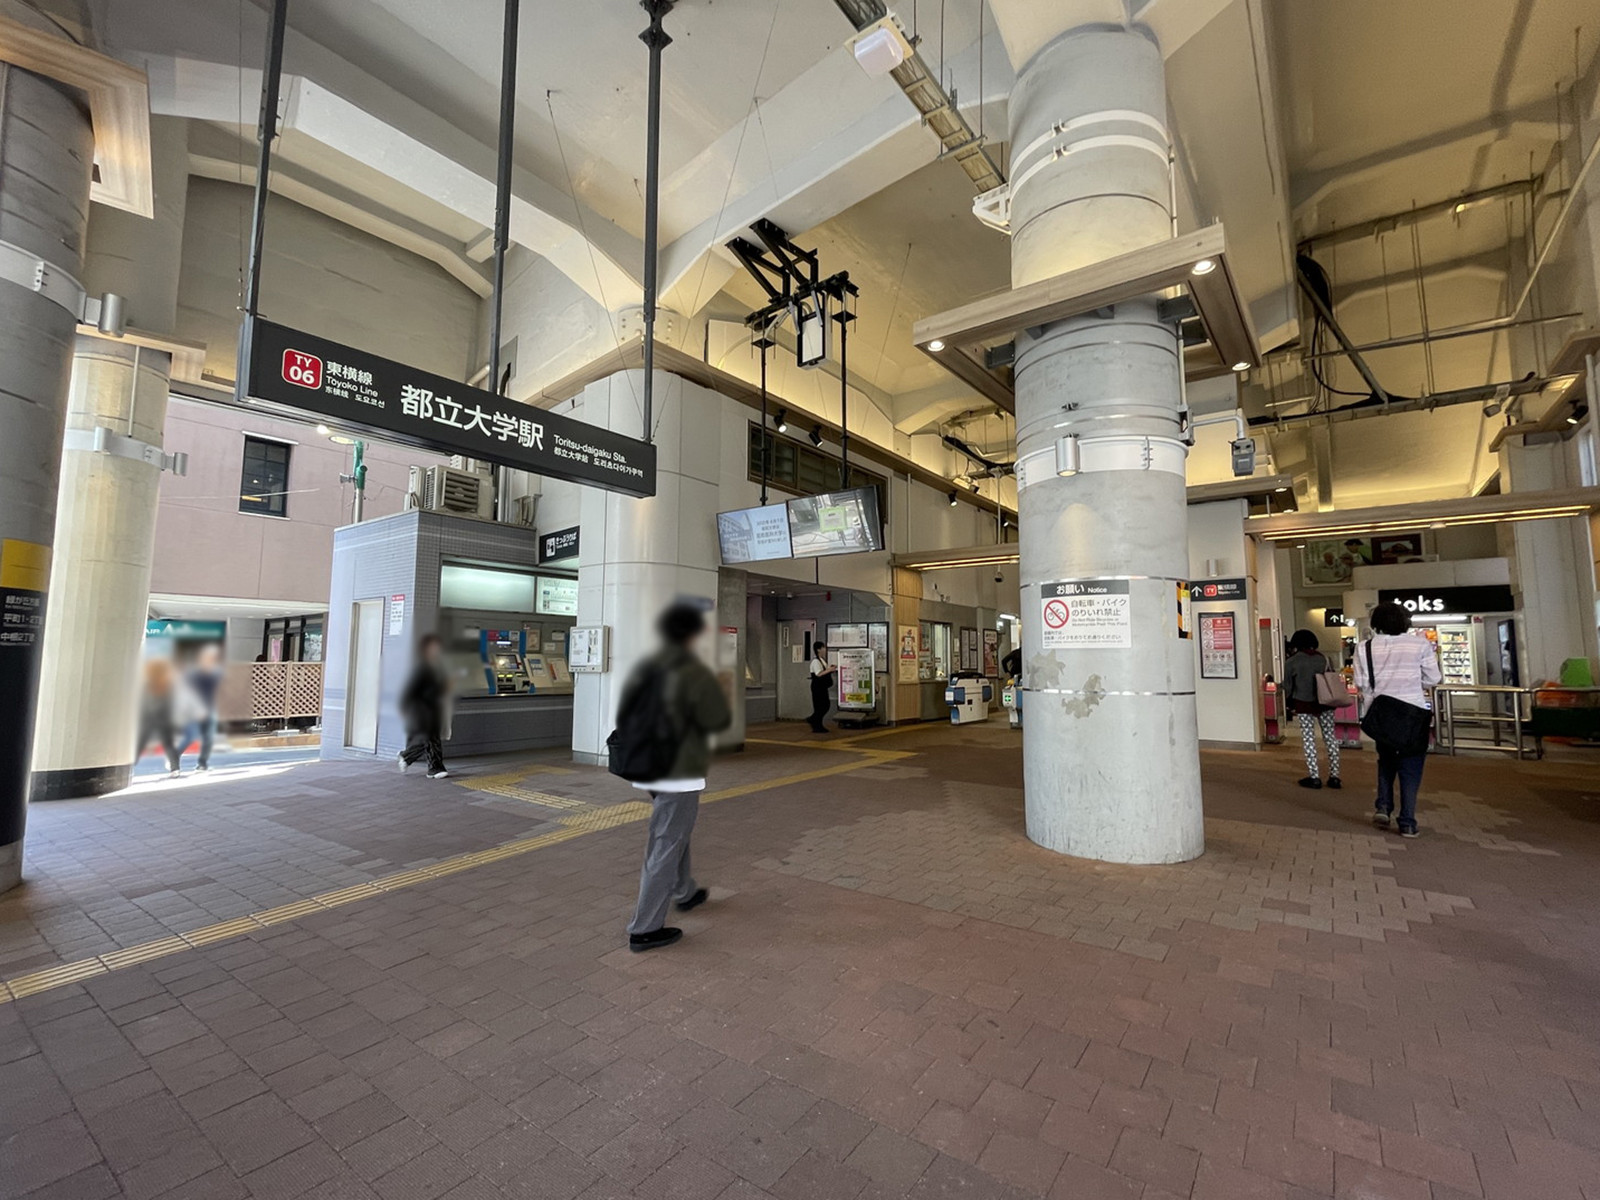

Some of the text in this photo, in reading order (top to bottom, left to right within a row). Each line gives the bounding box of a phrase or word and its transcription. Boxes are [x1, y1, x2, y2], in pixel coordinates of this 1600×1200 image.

[294, 354, 312, 368] TY
[289, 365, 315, 384] 06
[326, 360, 373, 386] 東横線
[326, 375, 379, 397] Toyoko Line
[400, 383, 545, 452] 都立大学駅
[553, 433, 627, 464] Toritsu-daigaku Sta.
[1056, 584, 1108, 595] お願い Notice
[1071, 599, 1127, 608] 自転車・バイク
[1071, 608, 1122, 617] のりいれ禁止
